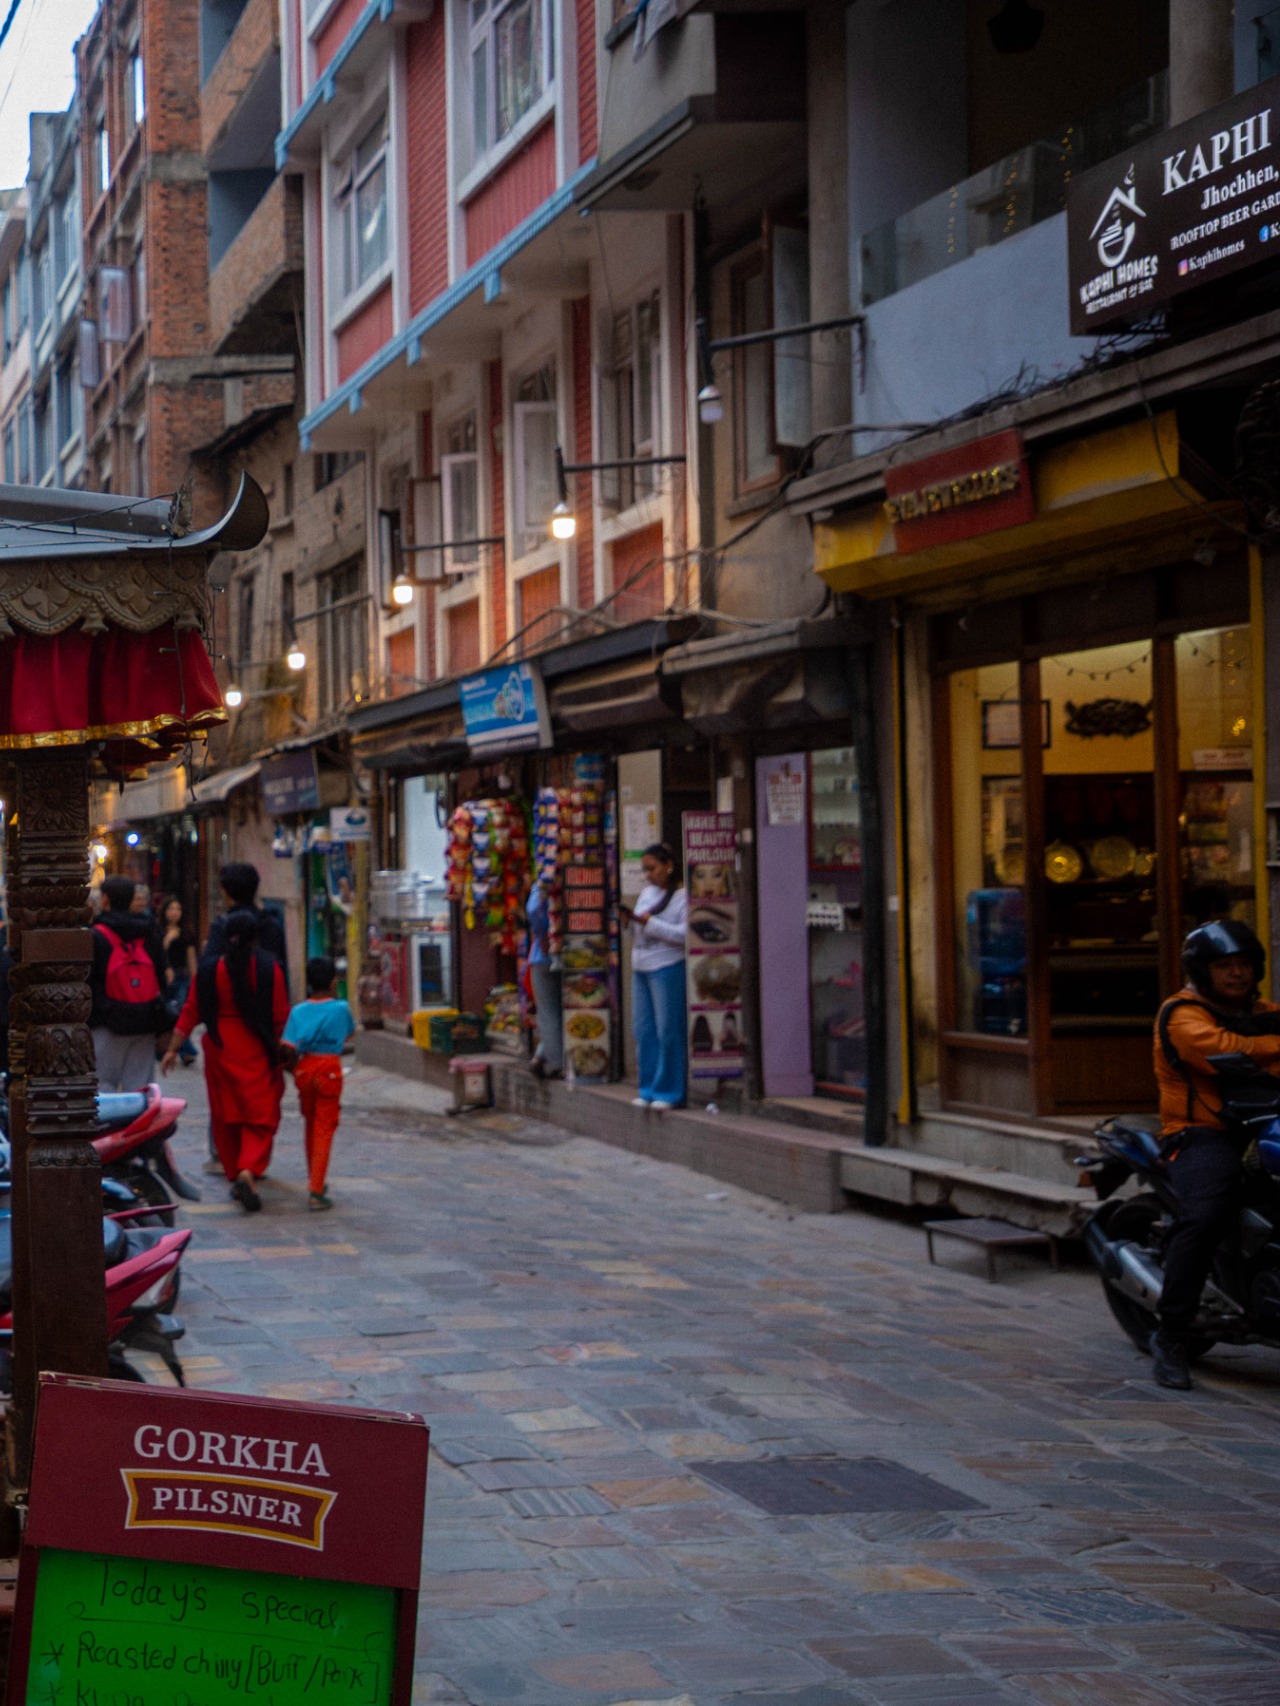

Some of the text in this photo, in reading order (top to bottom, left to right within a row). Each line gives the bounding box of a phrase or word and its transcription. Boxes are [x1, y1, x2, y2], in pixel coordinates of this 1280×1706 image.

[1161, 108, 1272, 196] KAPHI
[1170, 217, 1220, 251] ROOFTOP
[1220, 204, 1251, 230] BEER
[1188, 239, 1246, 271] Kaphihomes
[1079, 253, 1159, 305] KAPHI HOMES
[686, 847, 736, 862] PARLOUR
[688, 831, 733, 847] BEAUTY
[134, 1424, 331, 1478] GORKHA
[152, 1487, 303, 1527] PILSNER
[92, 1559, 208, 1623] Today's
[76, 1630, 177, 1671] Roasted
